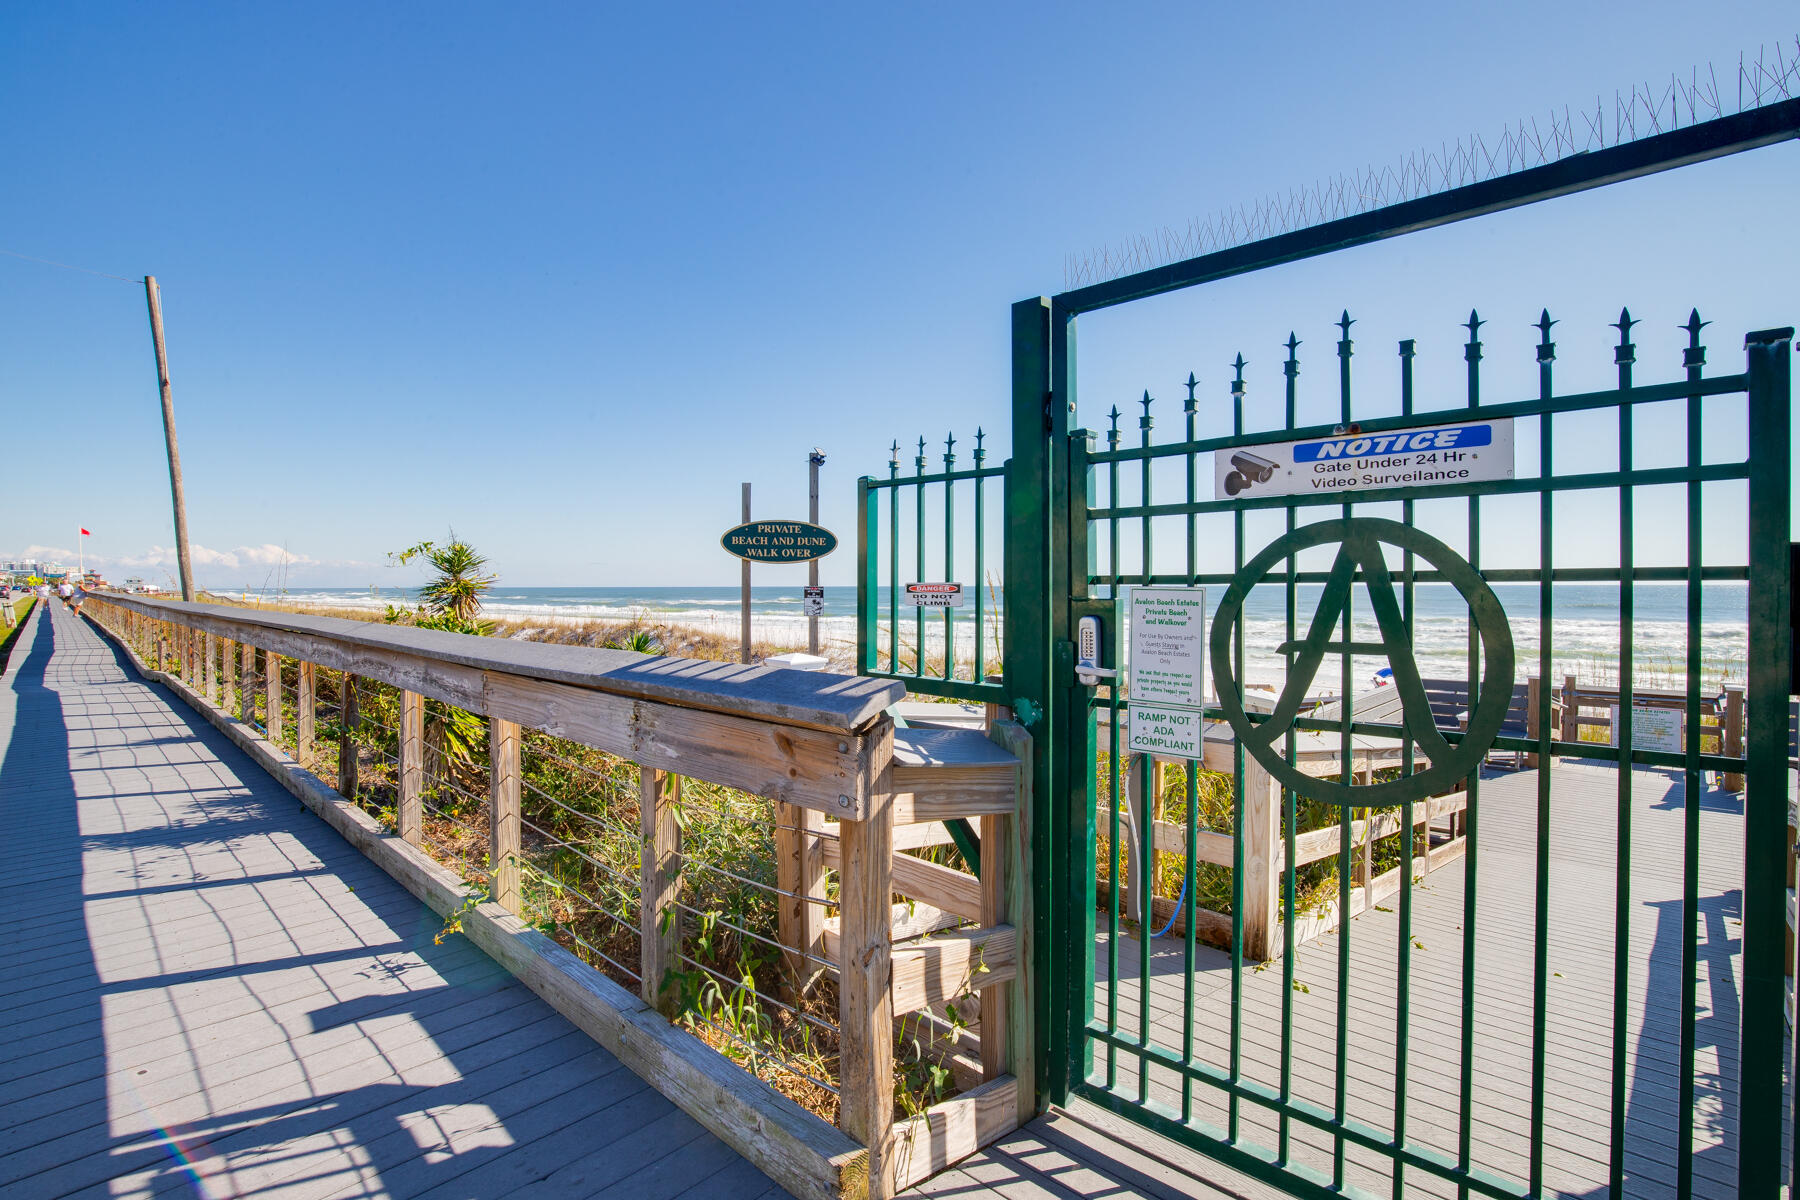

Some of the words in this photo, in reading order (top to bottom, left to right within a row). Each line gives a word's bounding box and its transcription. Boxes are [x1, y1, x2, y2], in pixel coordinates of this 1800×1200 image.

[1316, 429, 1463, 459] NOTICE
[1313, 462, 1351, 474] Gate
[1356, 456, 1410, 470] Under
[1416, 452, 1438, 465] 24
[1443, 451, 1467, 462] Hr
[1311, 477, 1357, 488] Video
[1362, 469, 1469, 485] Surveilance
[758, 524, 802, 534] PRIVATE
[732, 536, 768, 545] BEACH
[772, 537, 794, 546] AND
[797, 537, 826, 546] DUNE
[747, 548, 778, 557] WALK
[782, 549, 811, 558] OVER
[1138, 712, 1166, 722] RAMP
[1170, 715, 1191, 725] NOT
[1153, 726, 1175, 736] ADA
[1134, 736, 1195, 751] COMPLIANT
